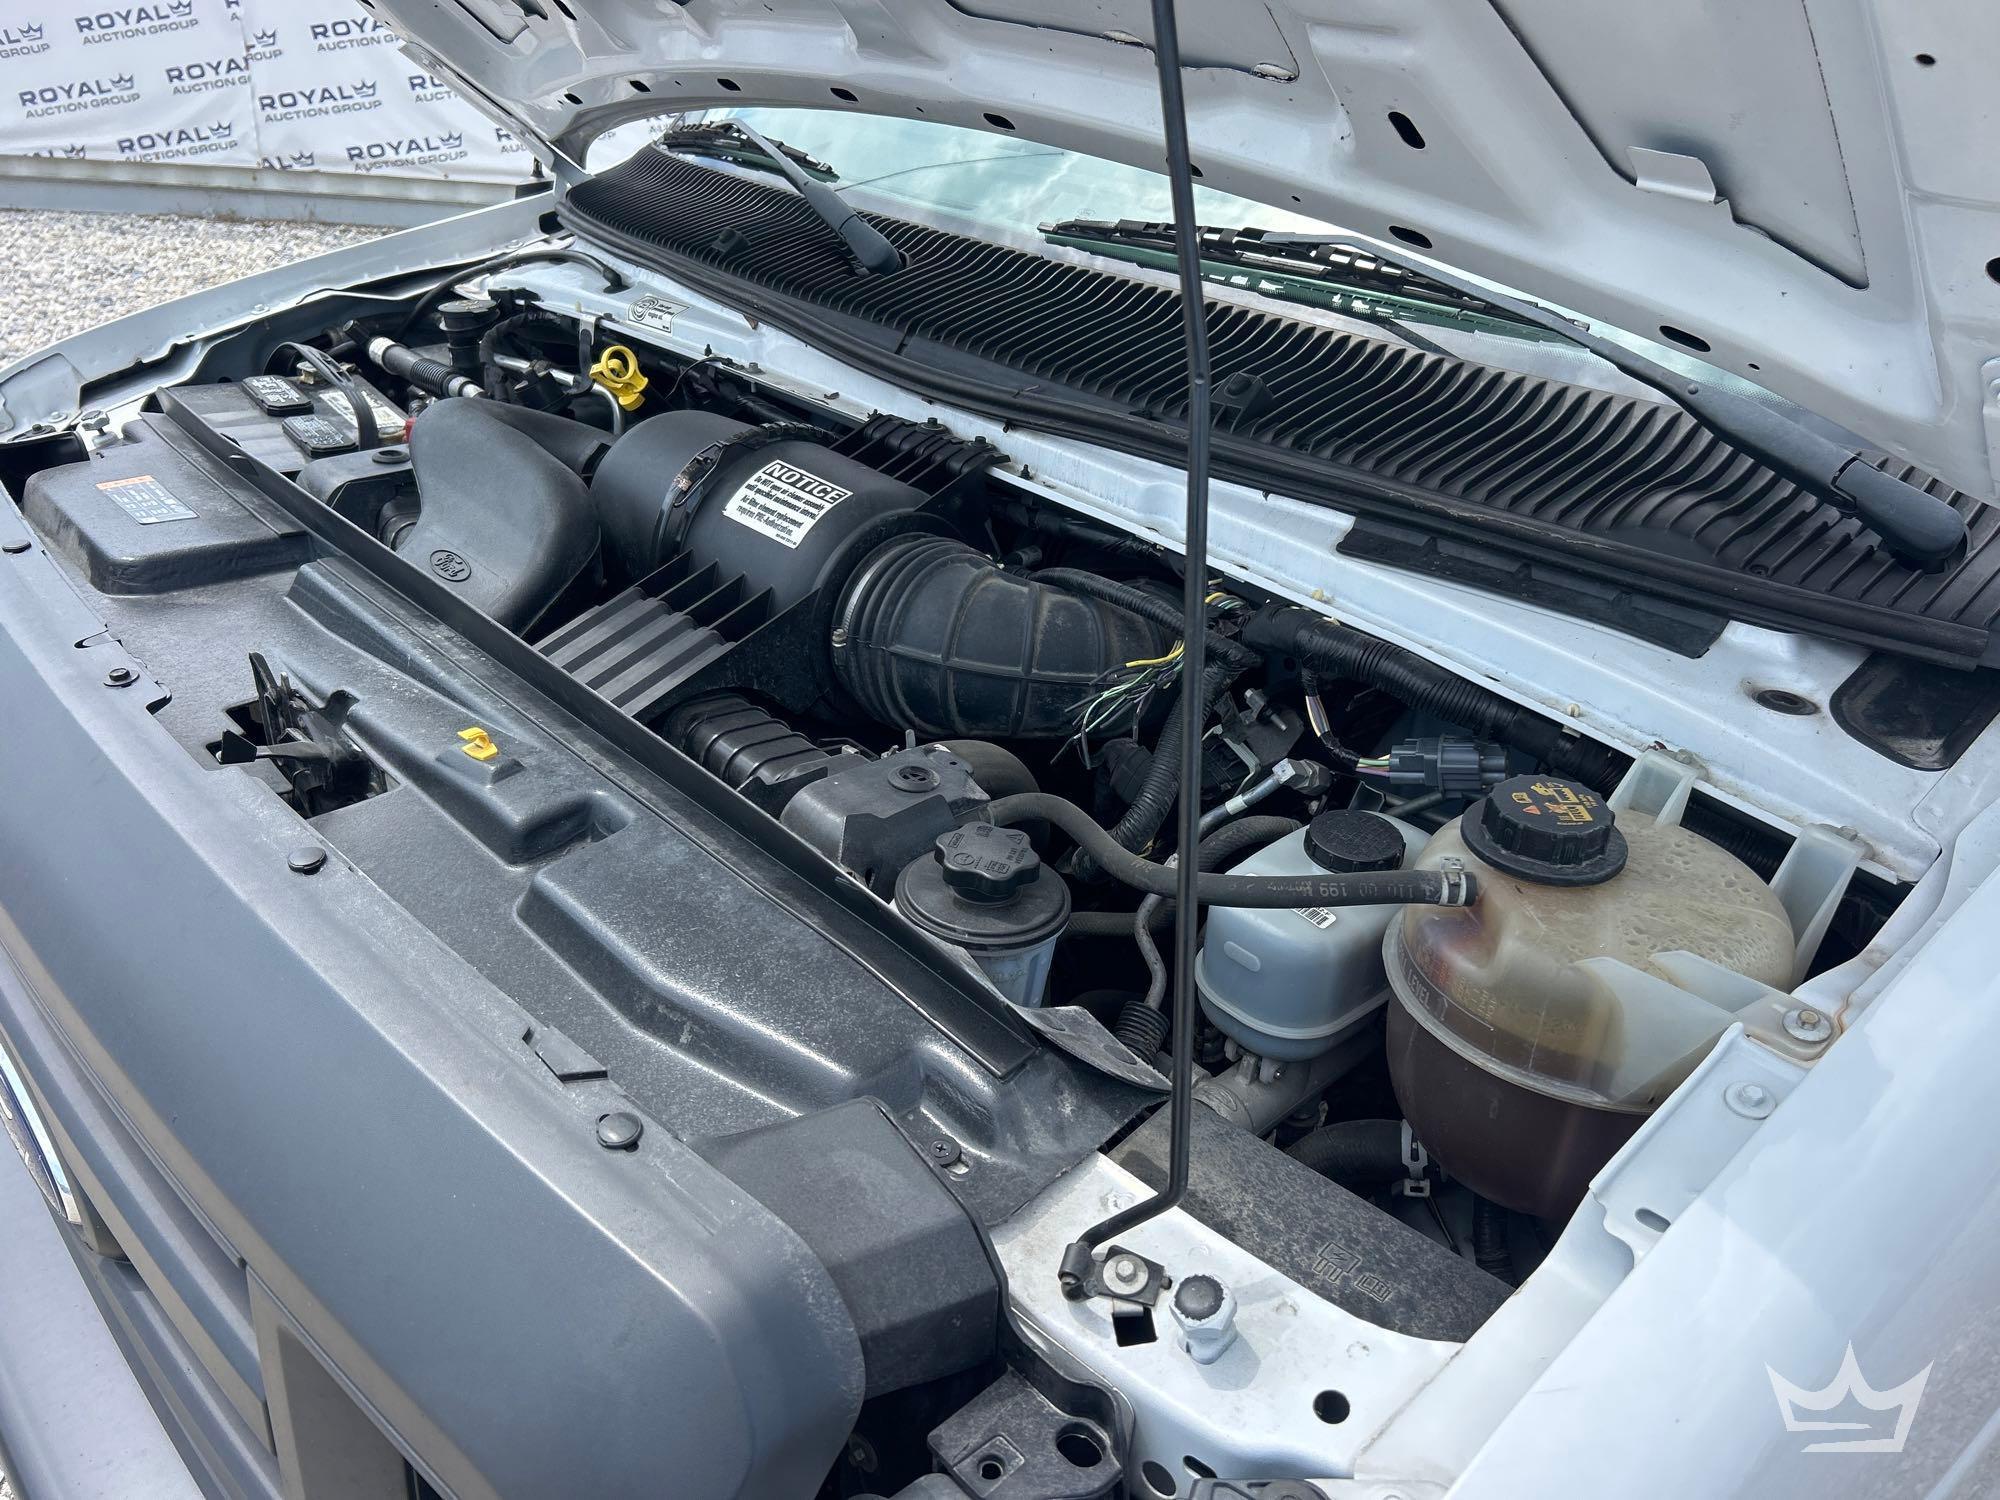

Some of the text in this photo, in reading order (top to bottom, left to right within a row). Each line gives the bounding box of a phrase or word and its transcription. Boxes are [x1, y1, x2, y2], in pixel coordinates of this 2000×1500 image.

[75, 5, 170, 33] ROYAL
[310, 17, 383, 40] ROY
[83, 19, 199, 45] AUCTION GROUP
[317, 35, 381, 52] AUCTION
[0, 43, 50, 58] GROUP
[247, 49, 283, 62] ROUP
[18, 79, 112, 107] ROYAL
[173, 77, 236, 95] AUCTION
[415, 90, 459, 103] AUCT
[26, 93, 141, 118] AUCTION GROUP
[258, 86, 354, 111] ROYAL
[265, 100, 382, 123] AUCTION GROUP
[117, 127, 210, 153] ROYAL
[125, 140, 238, 163] AUCTION GROUP
[346, 137, 440, 161] ROYAL
[354, 150, 468, 173] AUCTION GROUP
[765, 463, 847, 504] NOTICE
[433, 553, 465, 578] Ford
